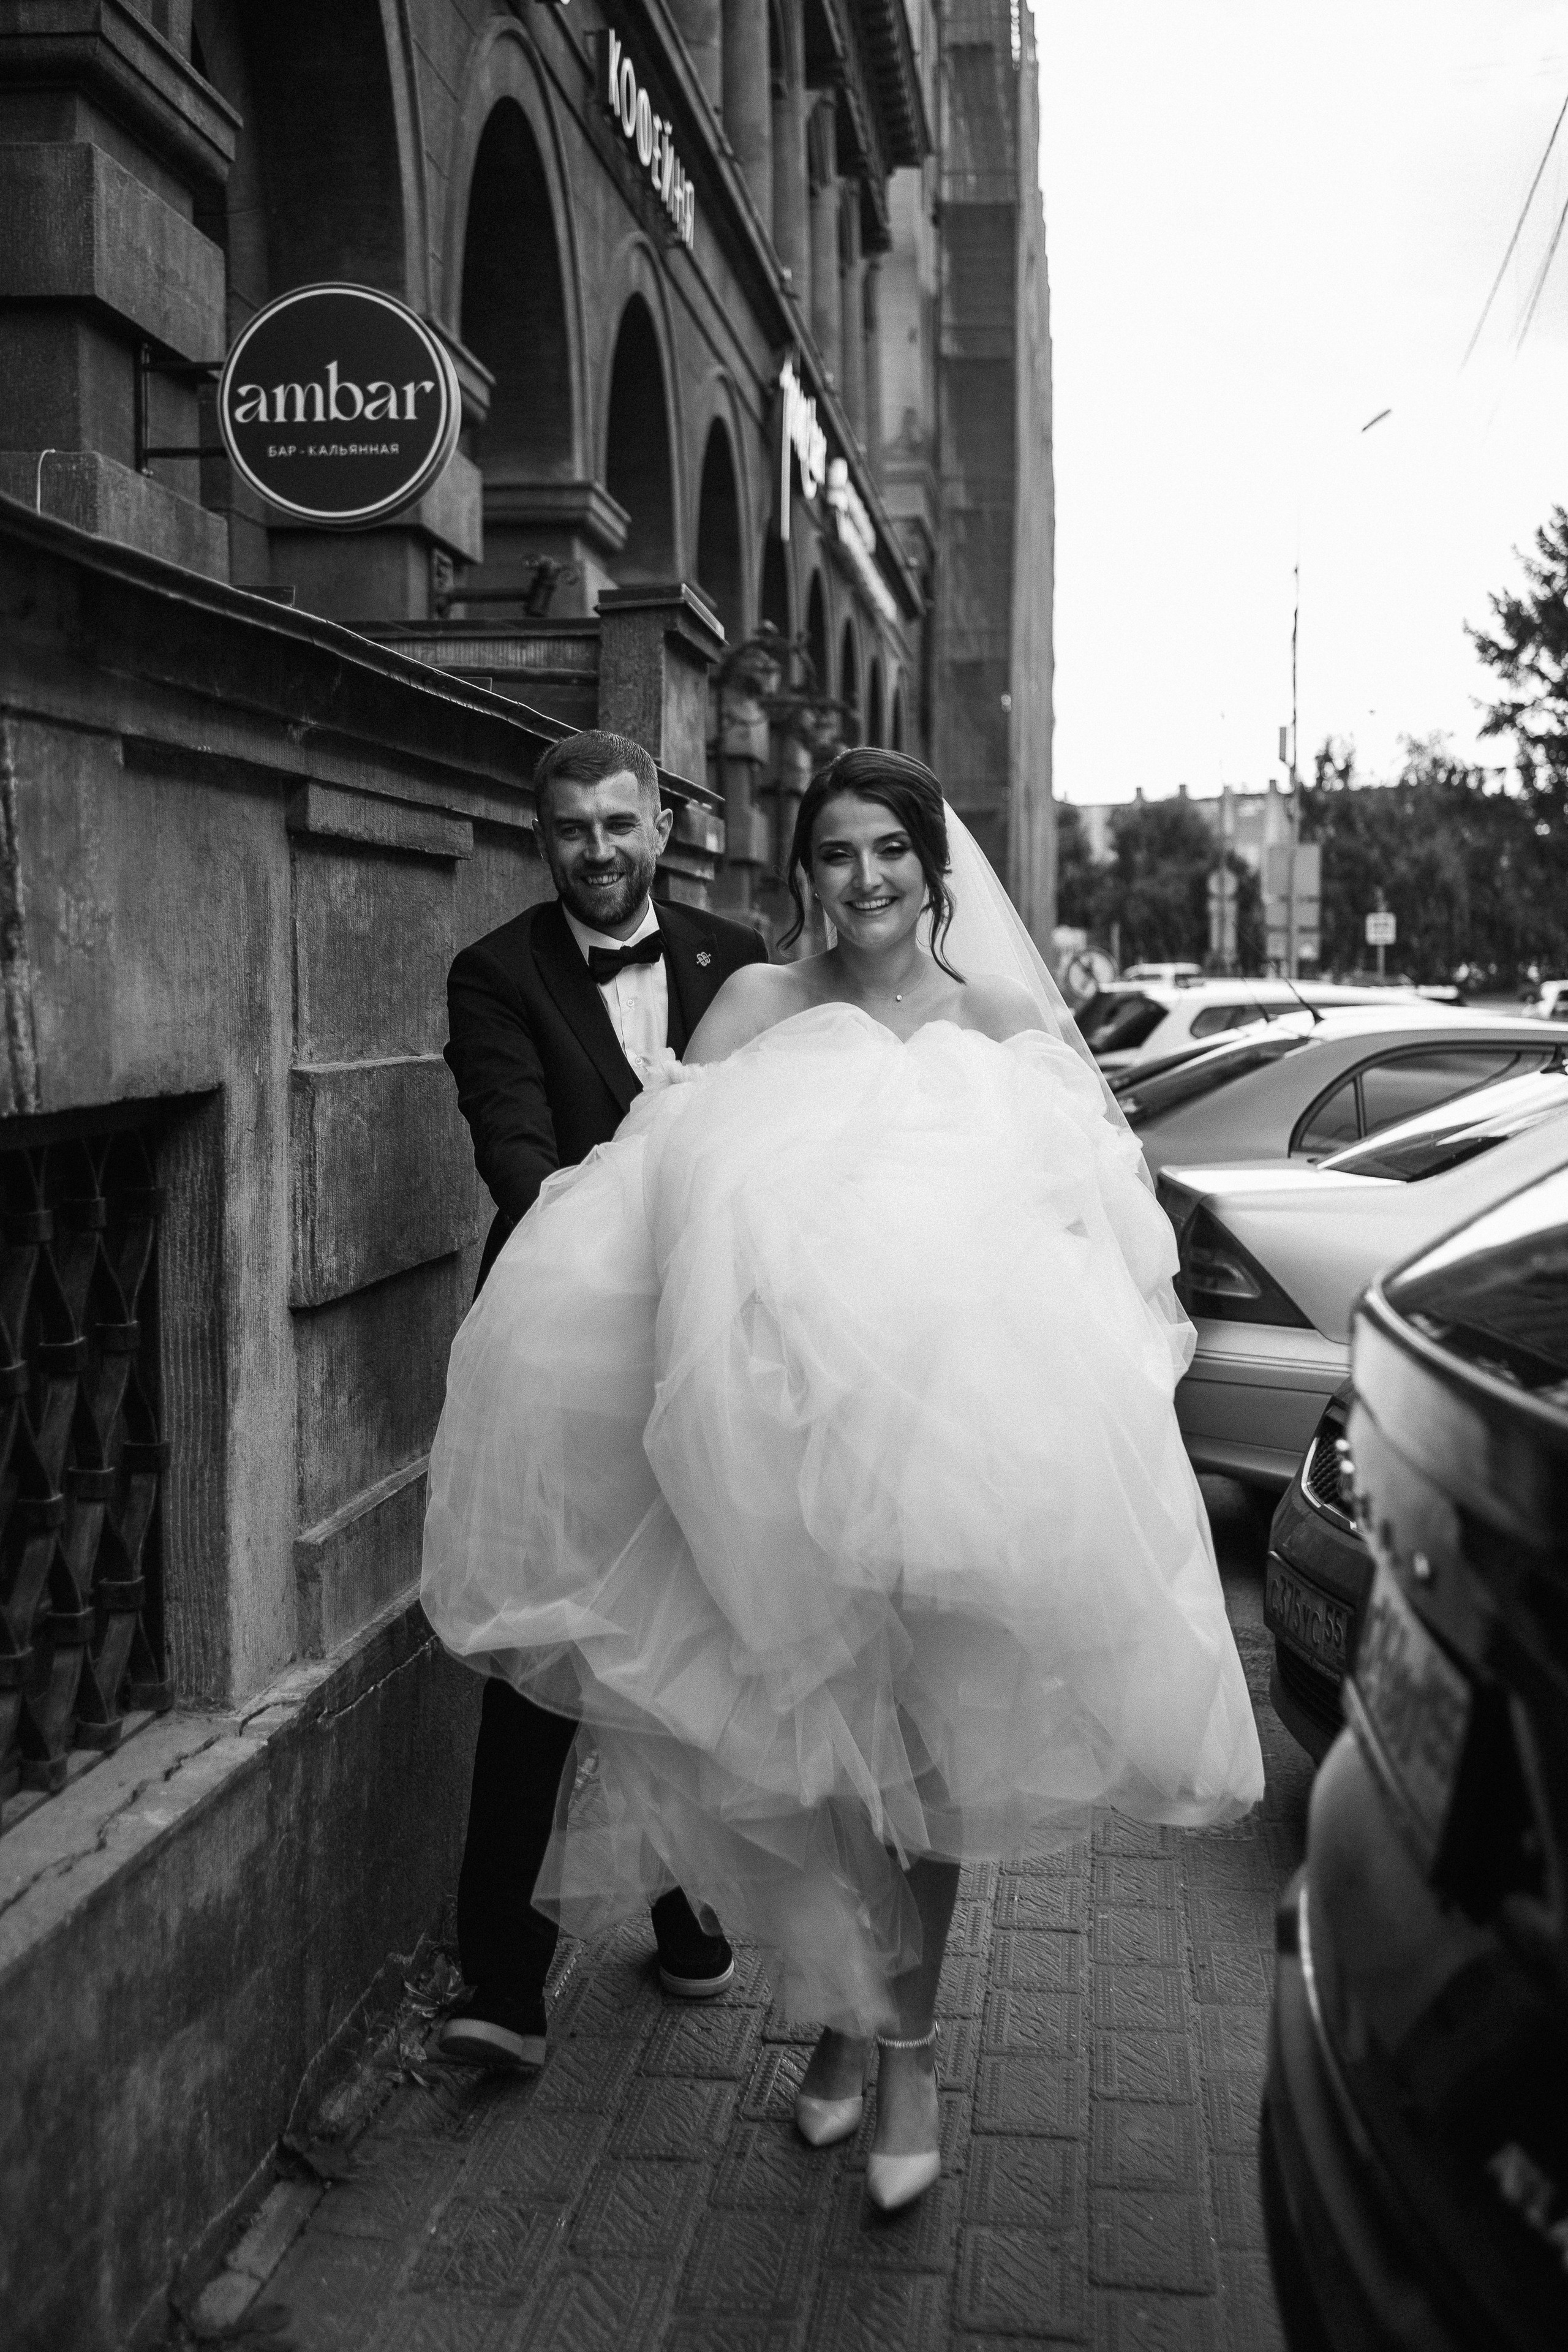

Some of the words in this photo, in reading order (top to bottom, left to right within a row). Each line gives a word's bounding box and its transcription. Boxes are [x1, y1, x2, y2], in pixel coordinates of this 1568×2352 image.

[609, 28, 694, 250] КОФЕЙНЯ
[235, 360, 435, 423] ambar
[268, 445, 296, 458] БАР
[309, 443, 399, 456] КАЛЬЯННАЯ
